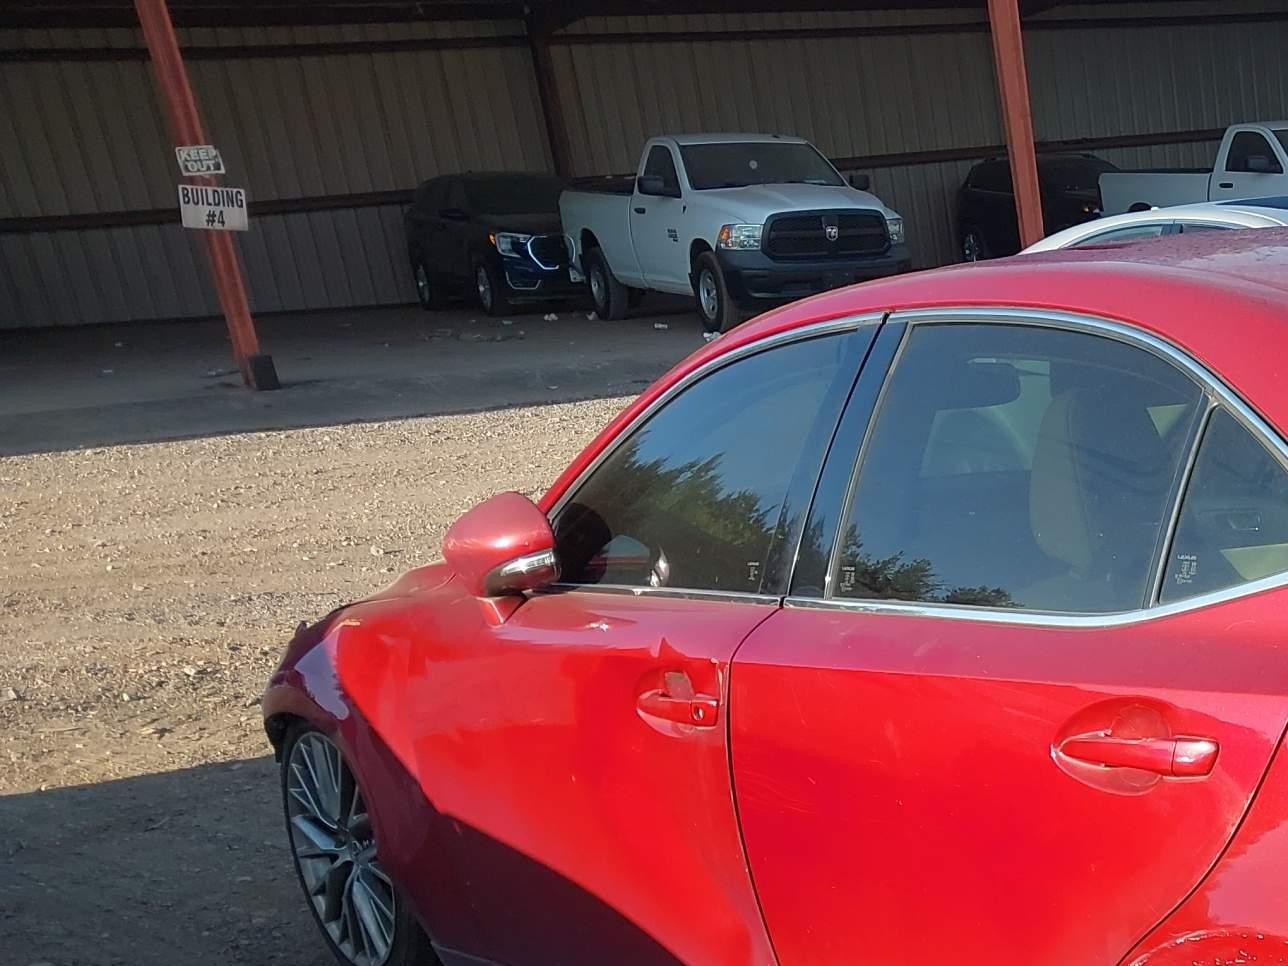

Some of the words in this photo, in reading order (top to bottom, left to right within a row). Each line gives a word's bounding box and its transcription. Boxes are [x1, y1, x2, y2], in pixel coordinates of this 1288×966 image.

[179, 148, 217, 161] KEEP
[186, 160, 216, 172] OUT
[181, 187, 244, 209] BUILDING
[205, 210, 226, 227] #4
